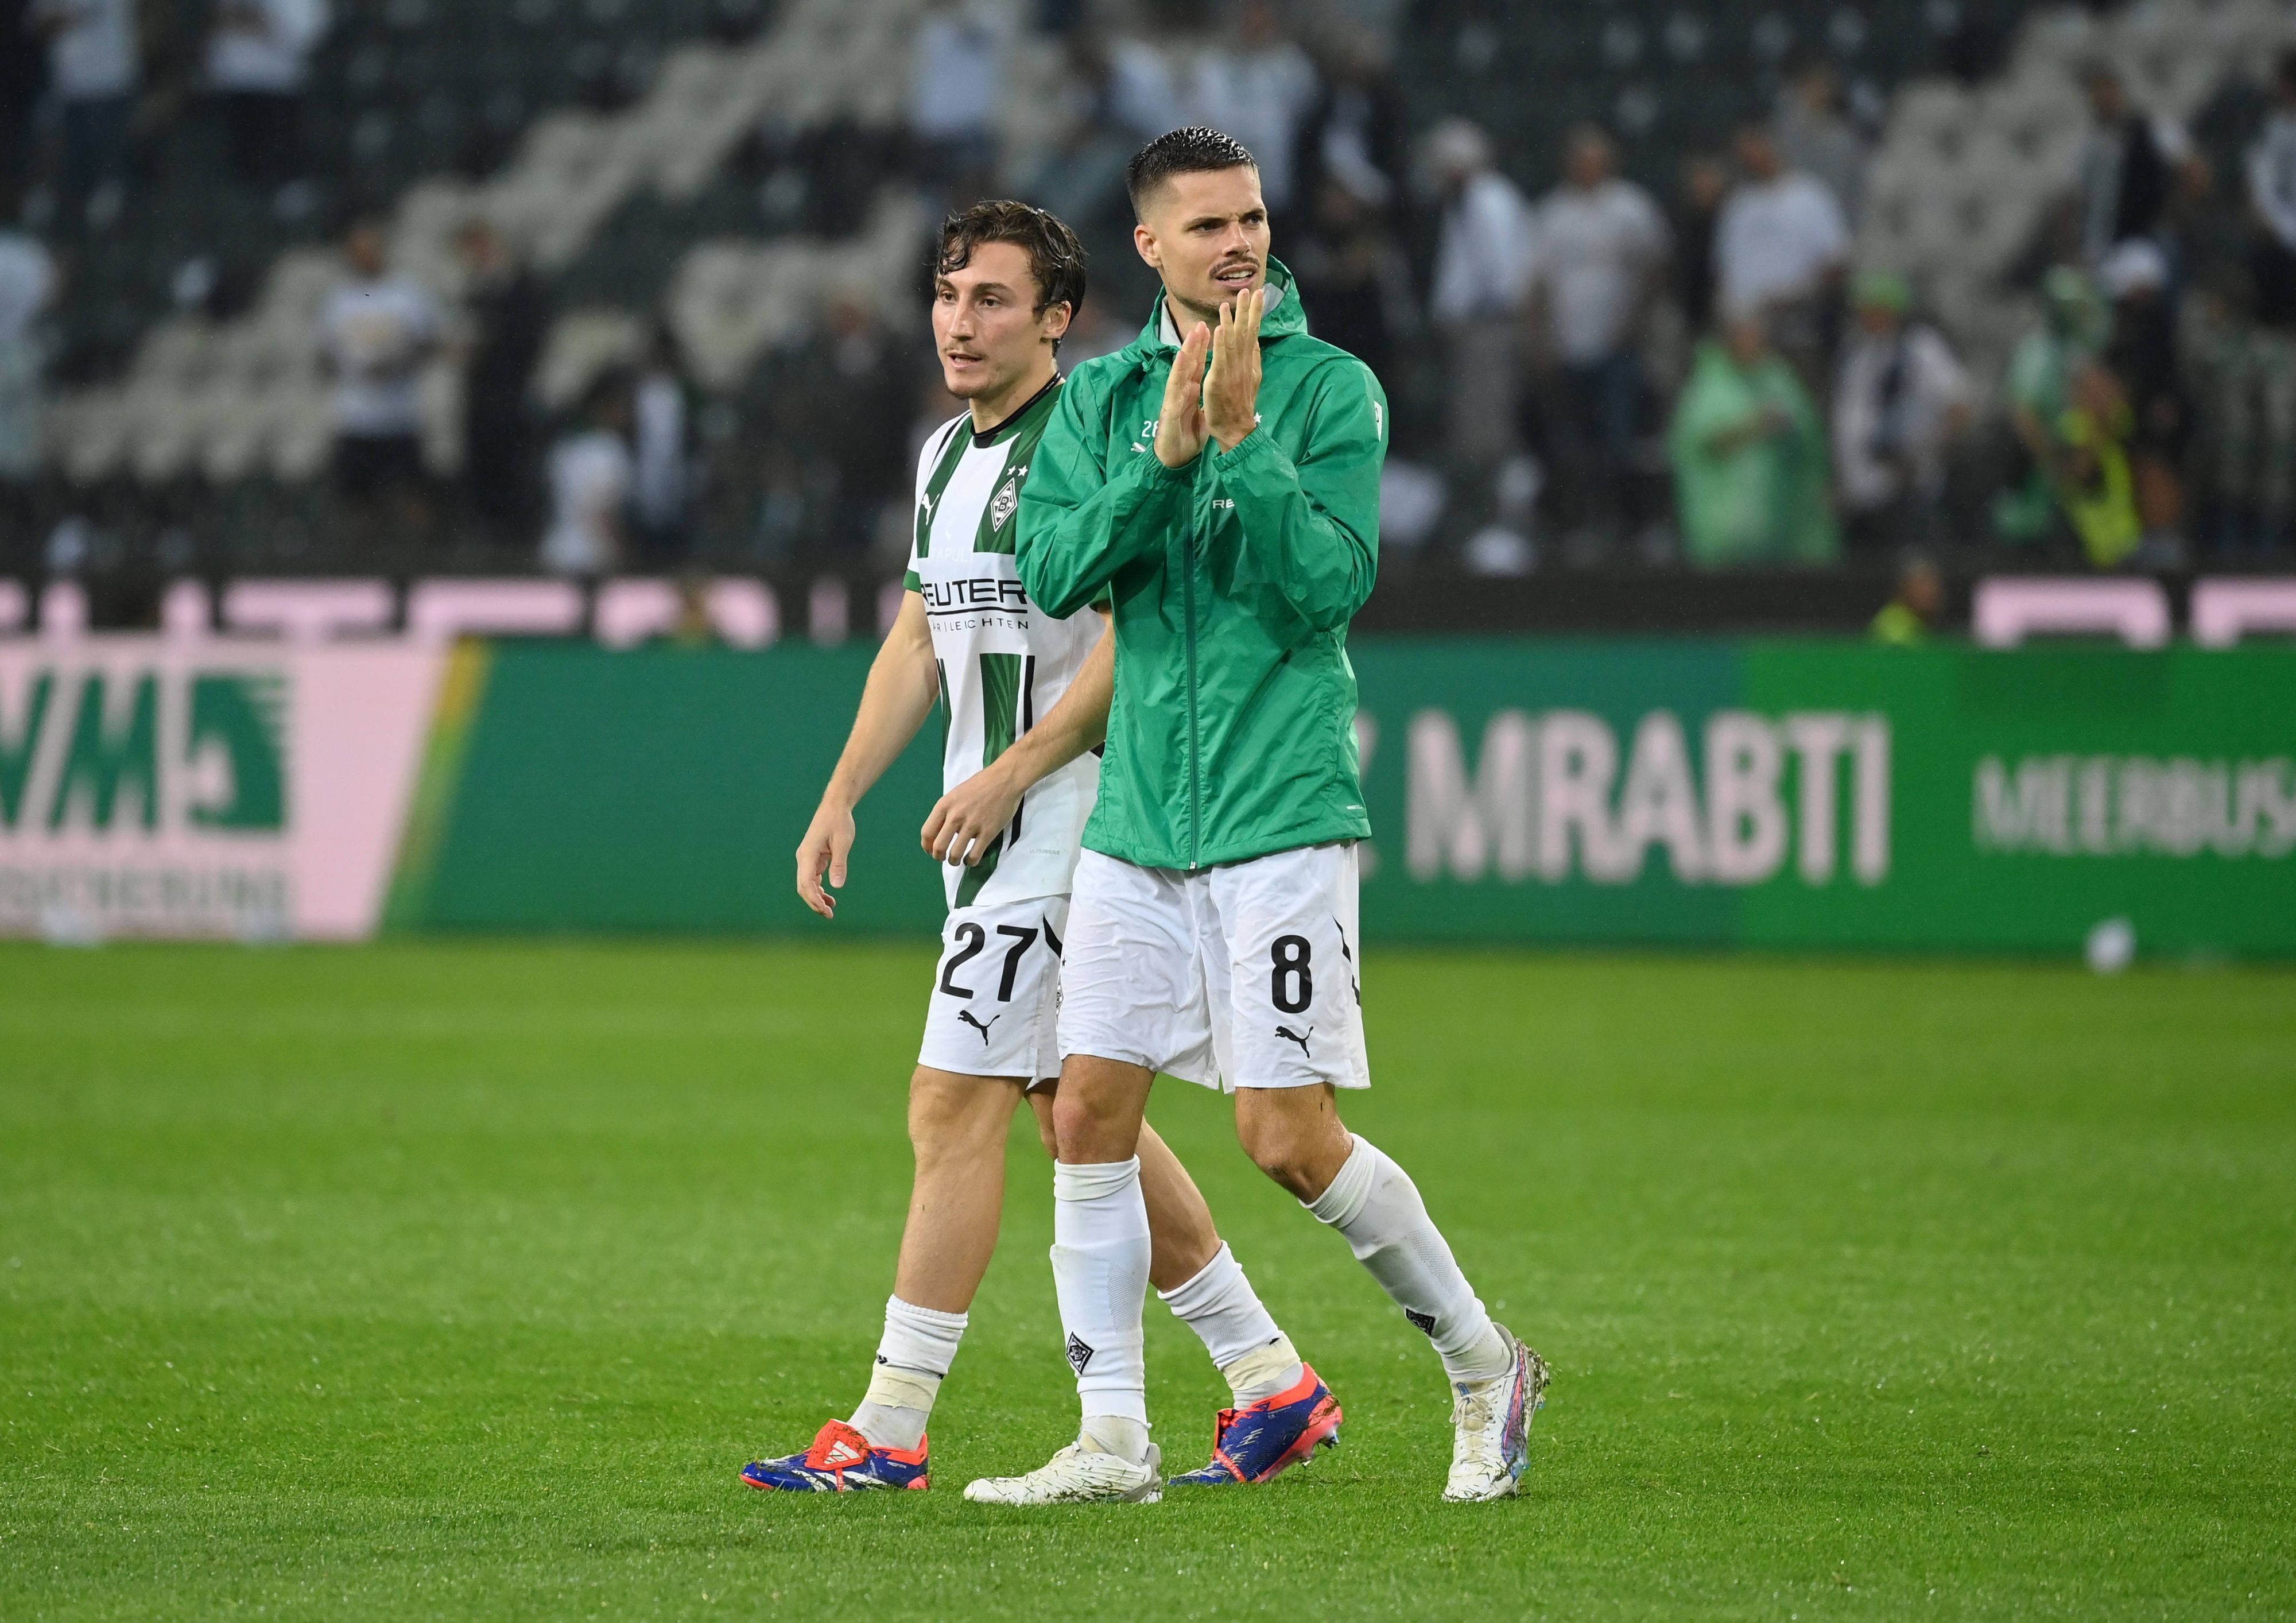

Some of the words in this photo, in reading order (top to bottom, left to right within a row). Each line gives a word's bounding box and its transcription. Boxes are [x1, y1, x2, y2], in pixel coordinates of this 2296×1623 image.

[1406, 708, 1891, 886] MRABTI
[939, 922, 1038, 1002] 27
[1271, 935, 1313, 1014] 8
